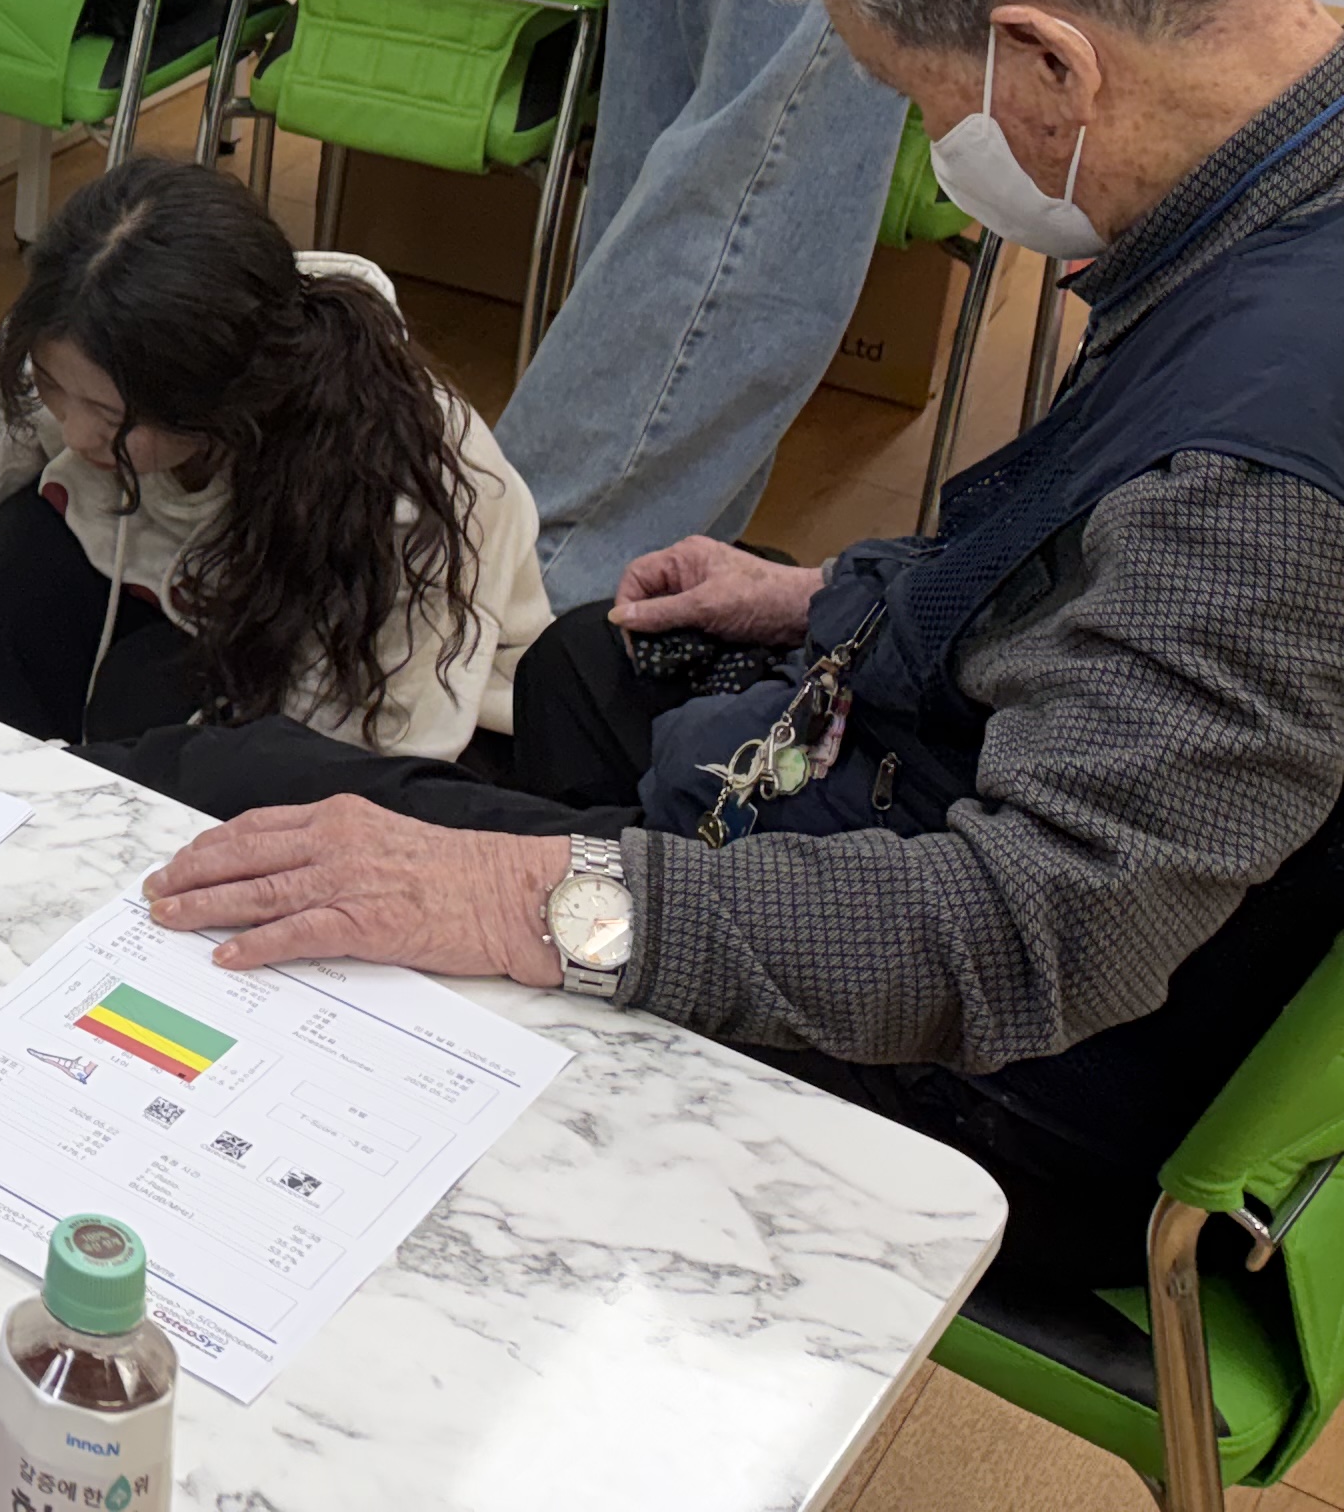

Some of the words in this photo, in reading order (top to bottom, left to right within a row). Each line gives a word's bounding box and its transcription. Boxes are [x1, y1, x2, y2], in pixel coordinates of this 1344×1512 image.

[840, 338, 885, 363] Ltd
[153, 1309, 226, 1354] OsteoSys
[66, 1432, 121, 1457] inno.N
[20, 1457, 77, 1503] 갈증에
